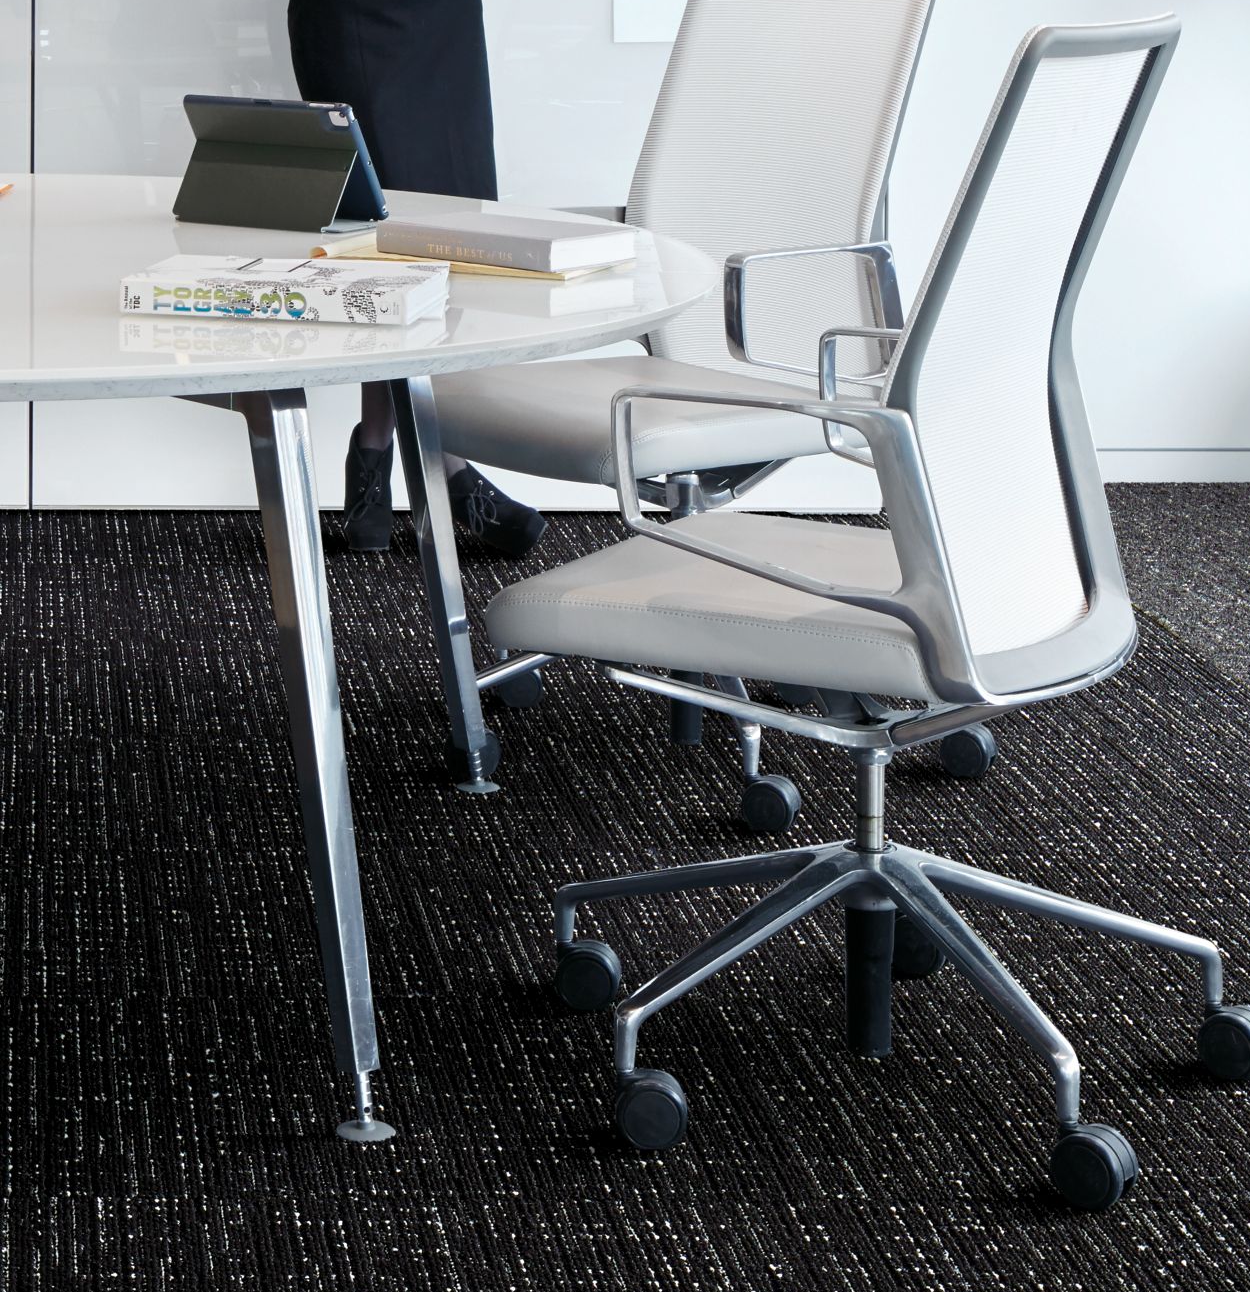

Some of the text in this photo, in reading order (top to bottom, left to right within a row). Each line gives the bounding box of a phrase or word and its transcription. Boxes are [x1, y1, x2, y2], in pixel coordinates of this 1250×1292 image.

[427, 243, 452, 256] THE
[456, 245, 485, 259] BEST
[499, 251, 513, 262] US
[133, 295, 141, 309] TDC
